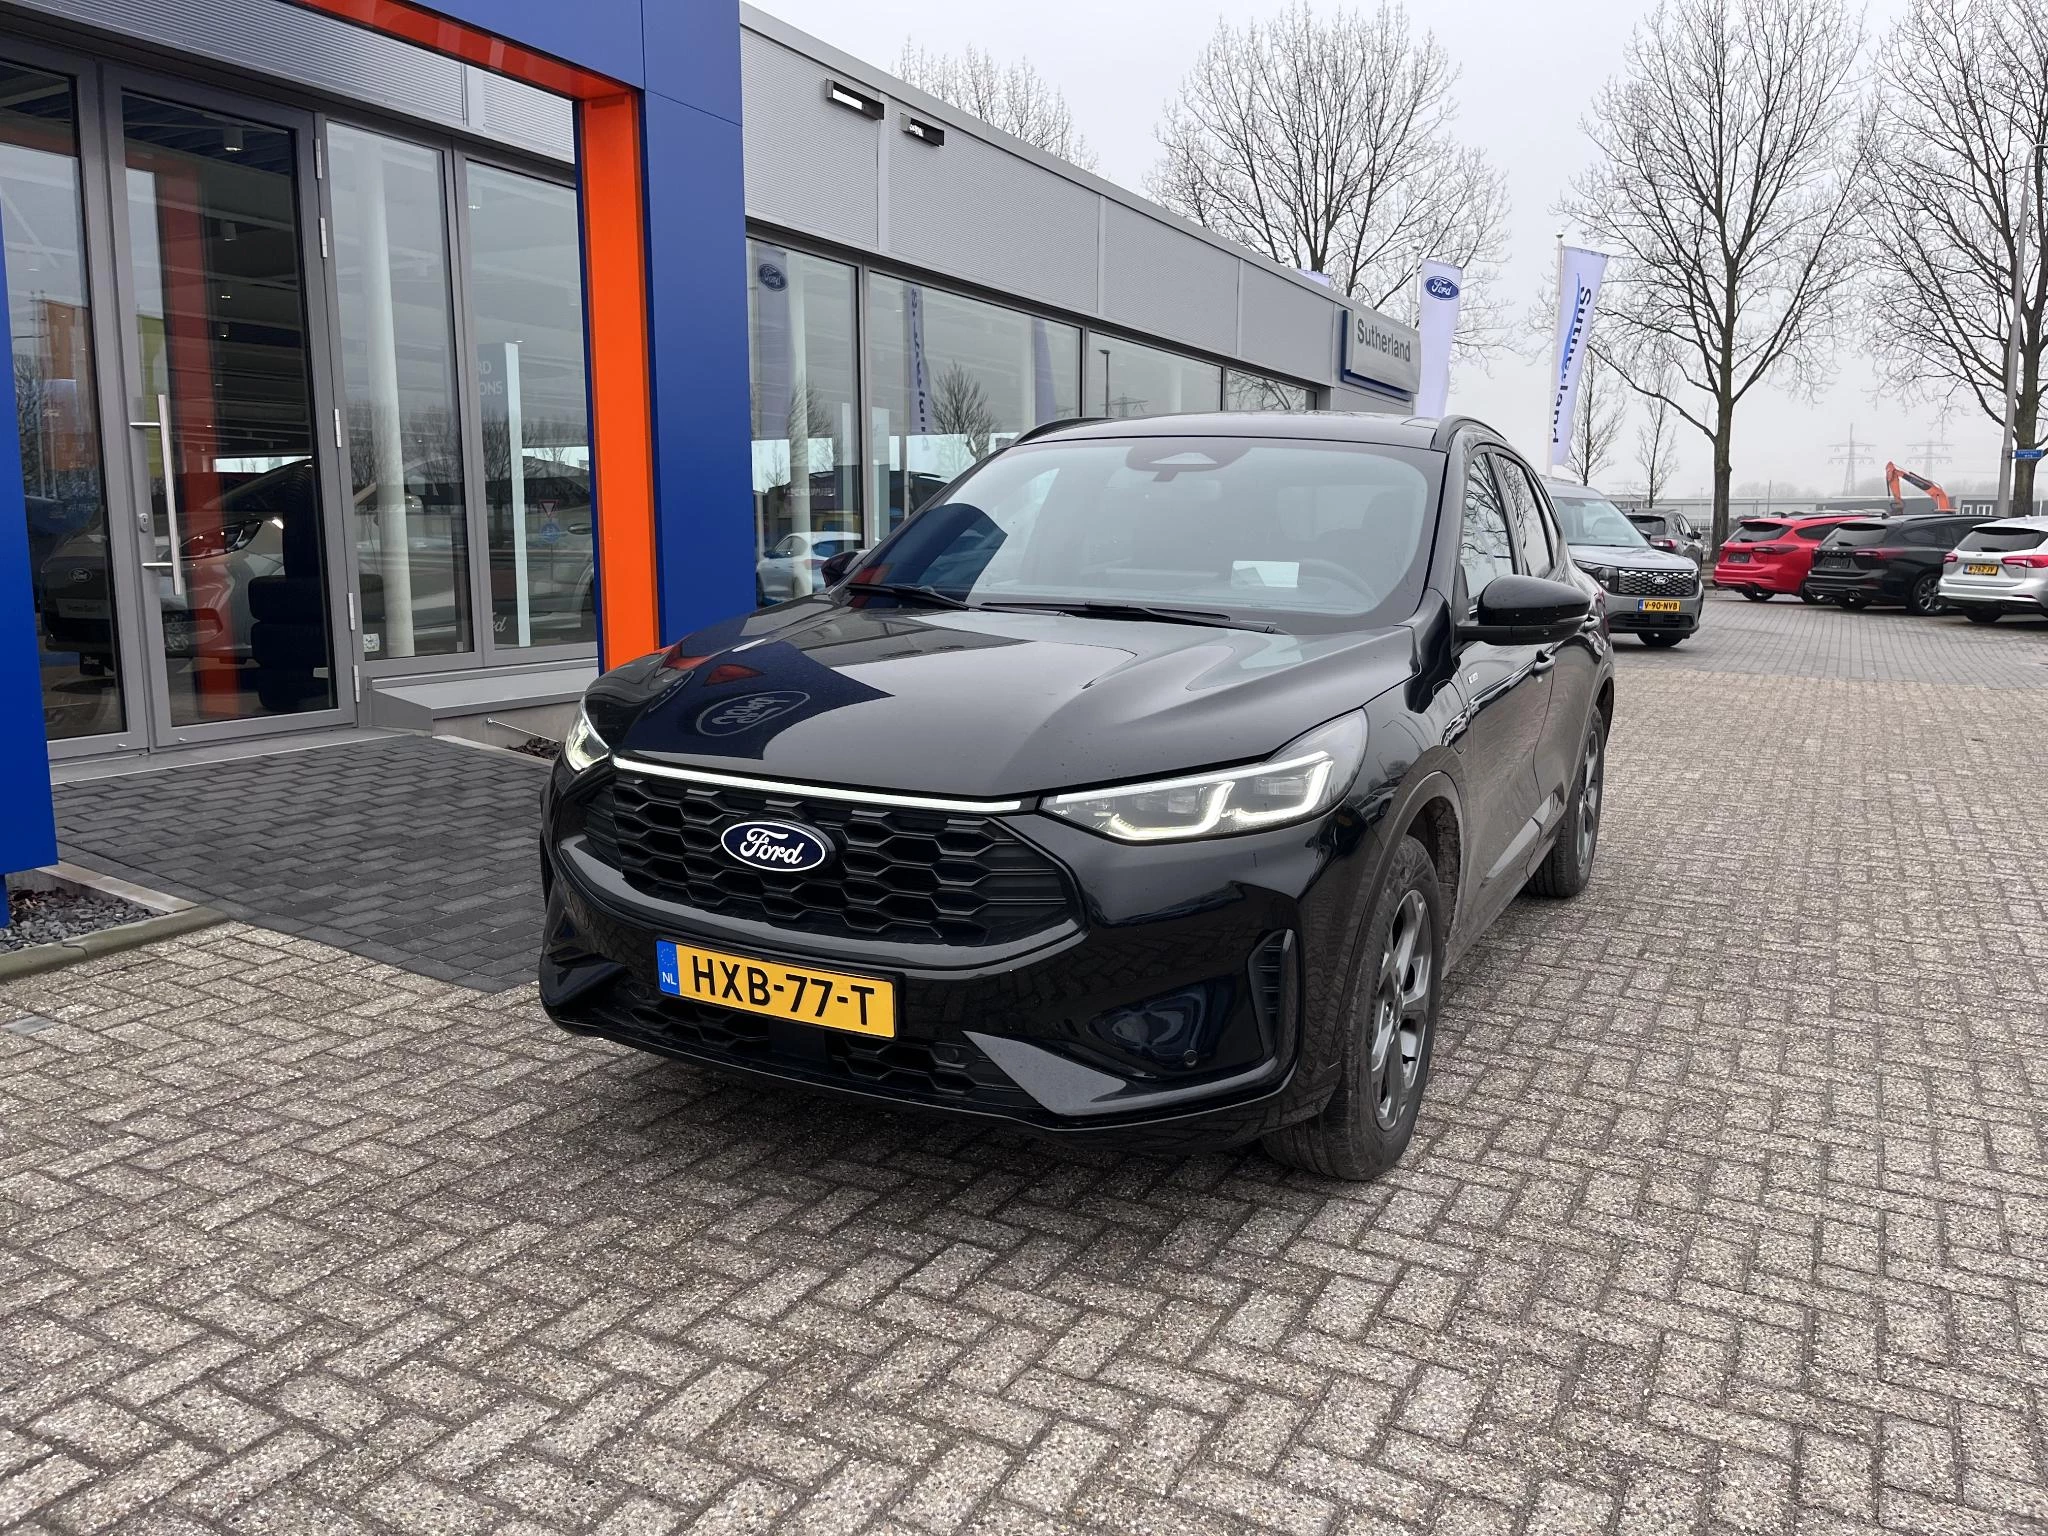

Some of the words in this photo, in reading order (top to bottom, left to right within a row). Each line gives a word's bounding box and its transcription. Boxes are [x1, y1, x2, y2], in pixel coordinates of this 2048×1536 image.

[1431, 279, 1452, 296] Ford
[1357, 318, 1411, 363] Sutherland
[1644, 601, 1678, 611] V-90-NVB
[739, 827, 805, 865] Ford
[661, 971, 678, 986] NL
[692, 955, 876, 1026] HXB-77-T
